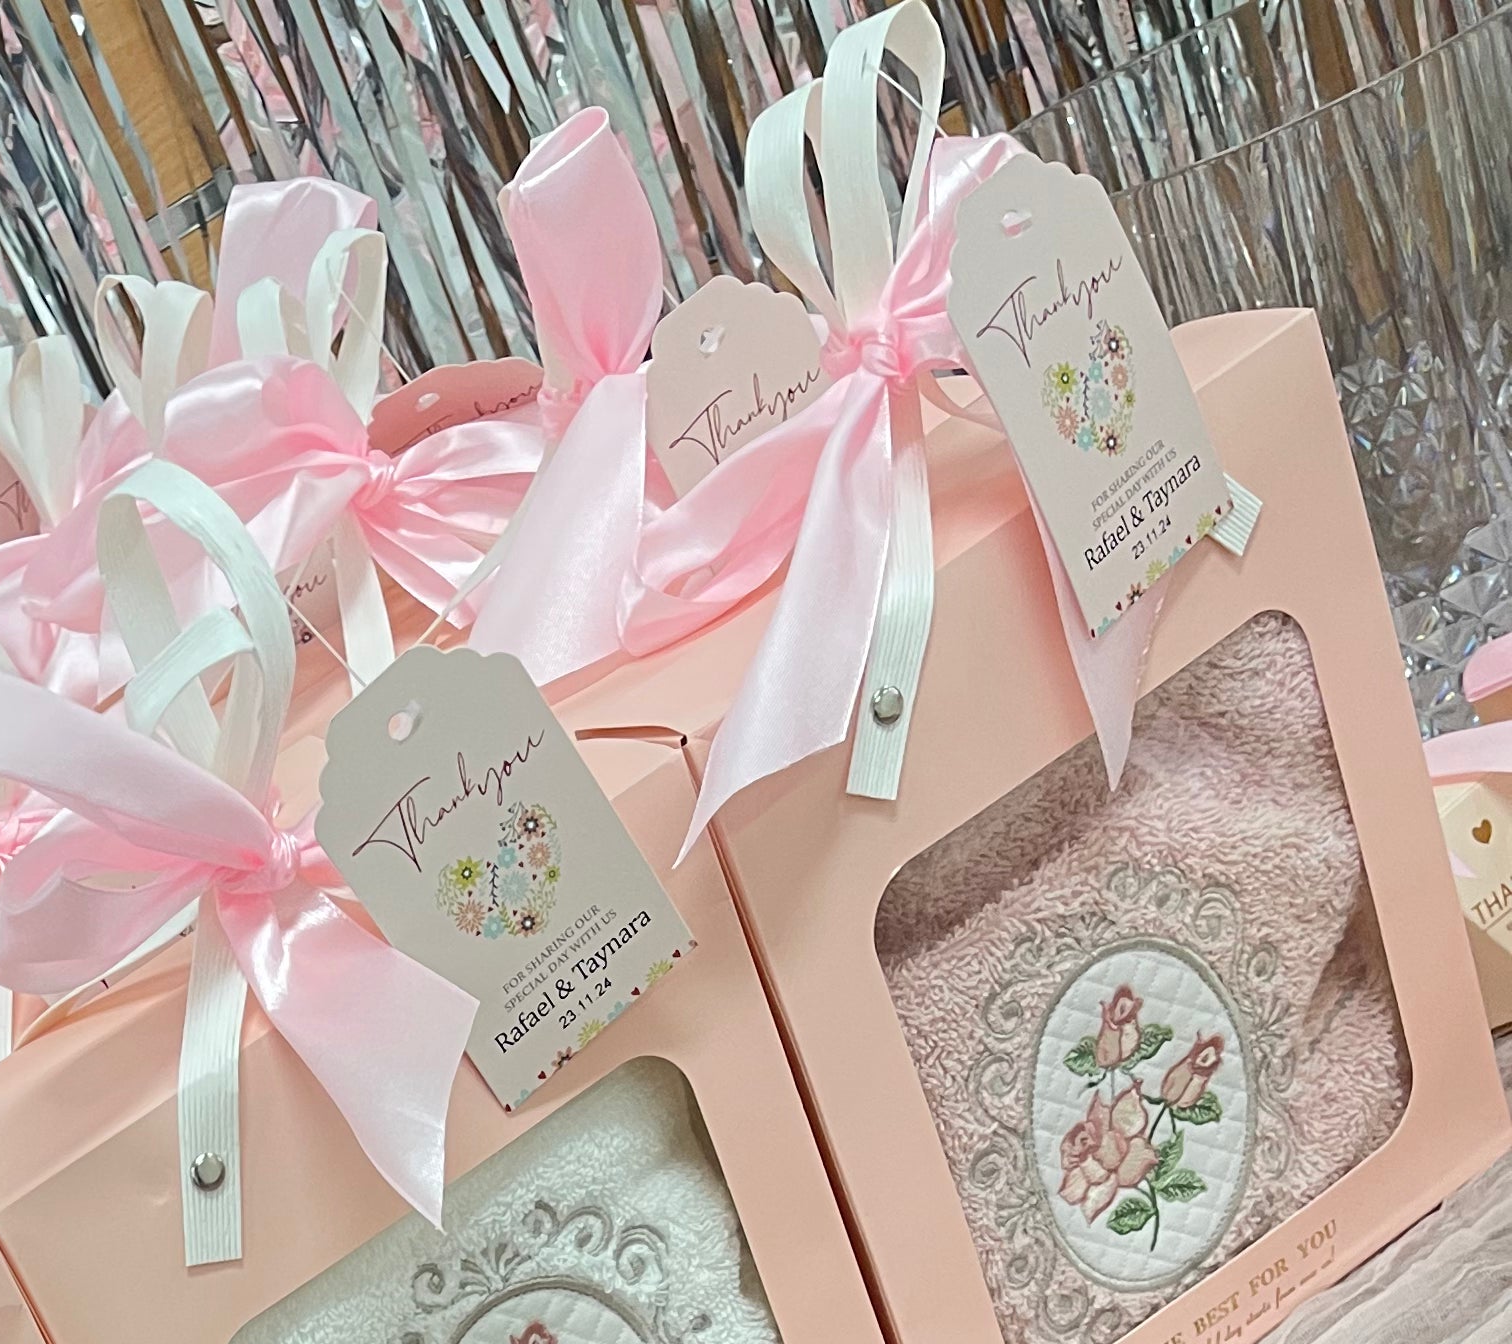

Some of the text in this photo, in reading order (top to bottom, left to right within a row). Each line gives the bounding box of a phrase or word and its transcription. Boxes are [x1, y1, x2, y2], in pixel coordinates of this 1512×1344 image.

[1084, 455, 1201, 571] Rafael & Taynara
[1091, 440, 1165, 512] FOR SHARING OUR
[1092, 448, 1177, 531] SPECIAL DAY WITH US
[1131, 515, 1172, 560] 23.11.24
[1470, 876, 1512, 925] THA
[494, 910, 652, 1054] Rafael & Taynara
[502, 904, 601, 995] FOR SHARING OUR
[504, 909, 617, 1013] SPECIAL DAY WITH US
[558, 977, 612, 1030] 23.11.24
[1193, 1291, 1241, 1338] BEST
[1248, 1258, 1290, 1298] FOR
[1295, 1219, 1338, 1259] YOU
